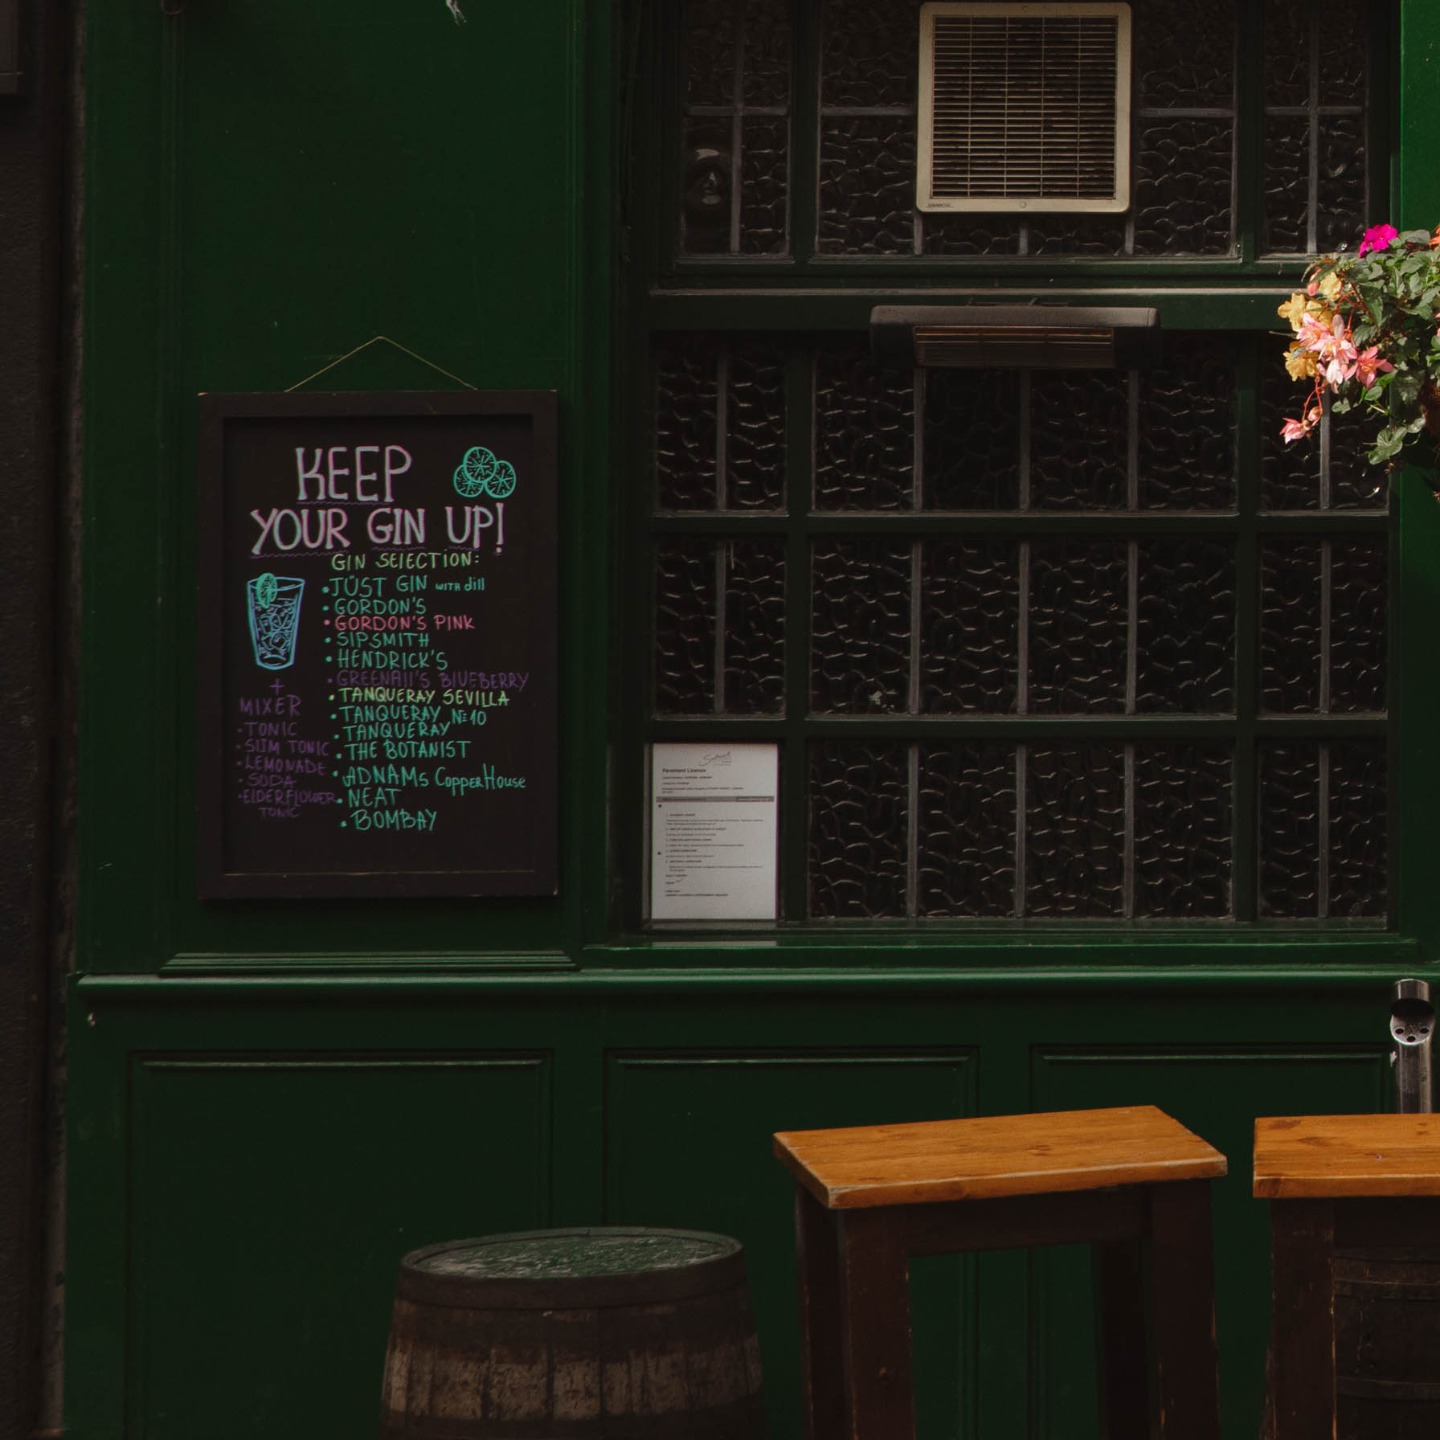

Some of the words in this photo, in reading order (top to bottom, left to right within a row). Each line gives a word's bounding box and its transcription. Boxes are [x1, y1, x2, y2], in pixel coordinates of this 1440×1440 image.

[295, 445, 413, 503] KEEP
[250, 507, 351, 555] YOUR
[367, 507, 426, 545] GIN
[444, 502, 504, 554] UP!
[330, 553, 366, 571] GIN
[396, 574, 428, 593] GIN
[334, 596, 427, 615] GORDON'S
[334, 615, 428, 631] GORDON'S
[433, 614, 475, 630] PINK
[336, 631, 430, 648] SIPSMITH
[337, 649, 448, 670] HENDRICK'S
[239, 694, 301, 717] MIXER
[338, 686, 436, 705] TANQUERAY
[442, 689, 510, 707] SEVILLA
[339, 704, 441, 724] TANQUERAY
[244, 721, 298, 736] TONIC
[342, 721, 451, 742] TANQUERAY
[287, 740, 330, 757] TONIC
[344, 741, 378, 760] THE
[383, 739, 472, 760] BOTANIST
[245, 754, 327, 776] LEMONADE
[248, 772, 297, 789] SODA
[349, 786, 402, 808] NEAT
[350, 808, 438, 831] BOMBAY
